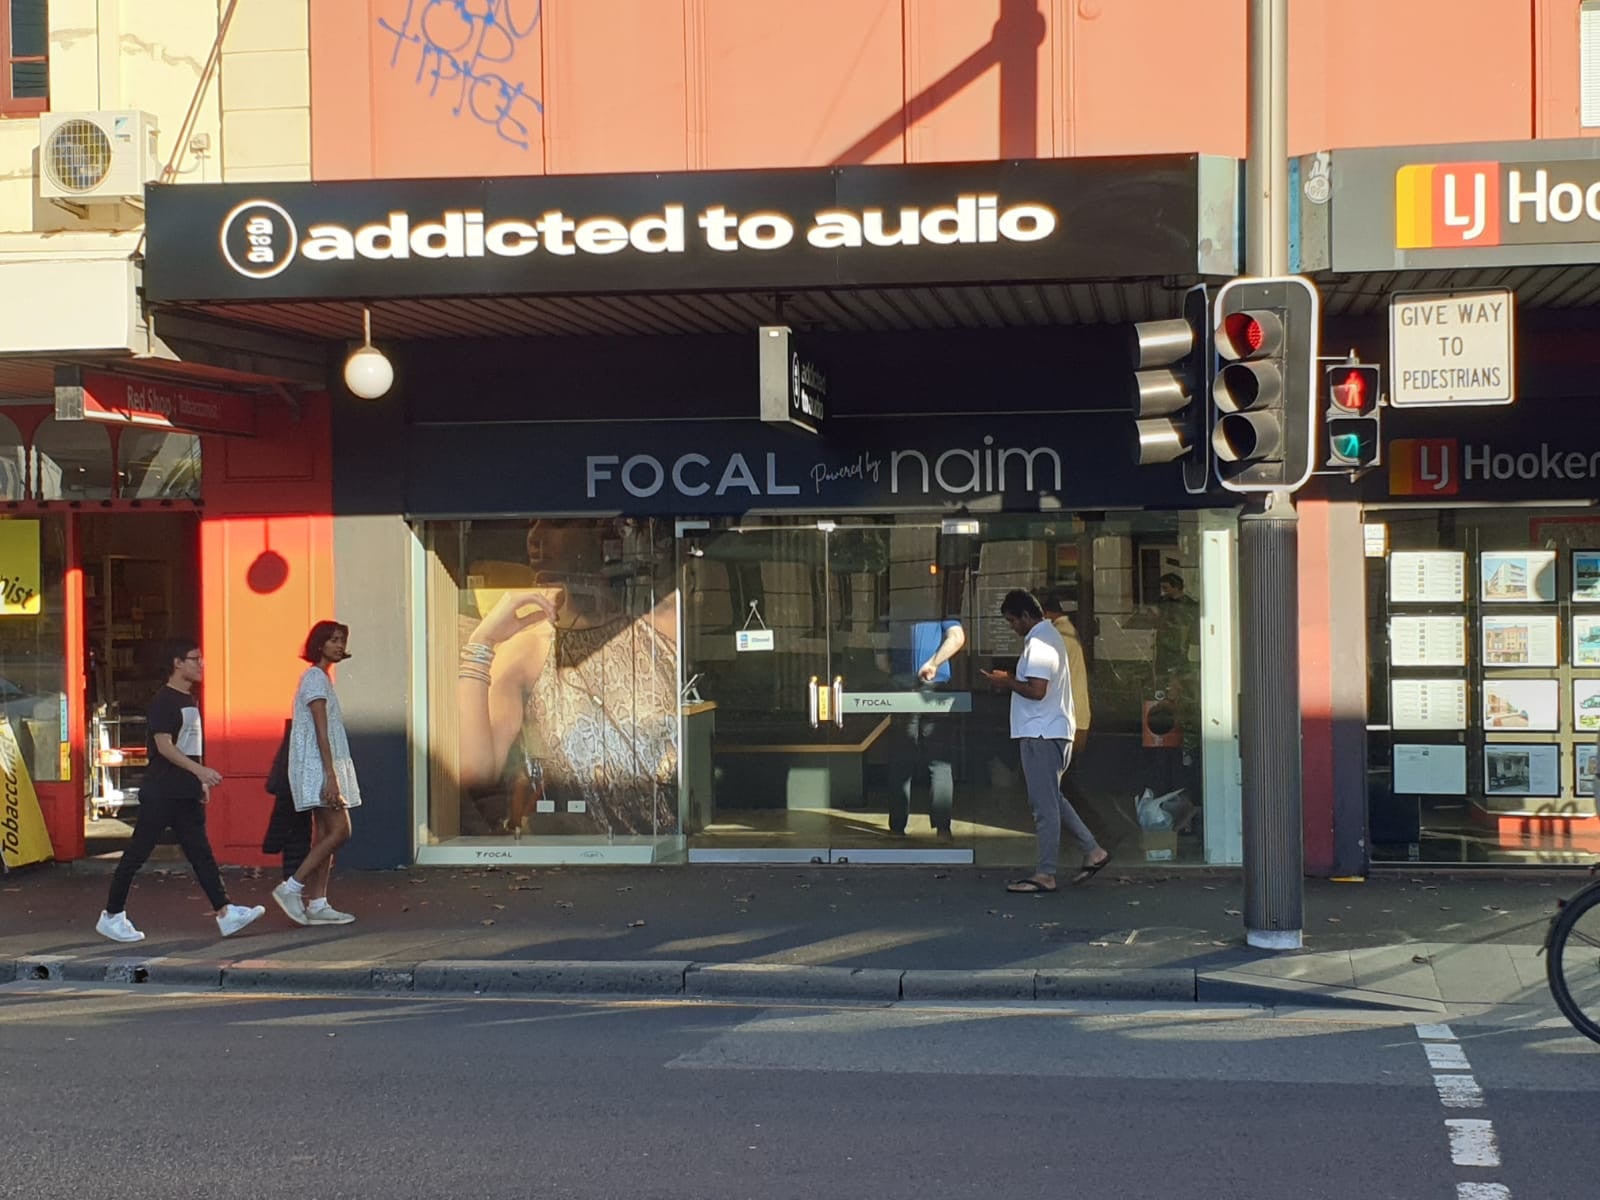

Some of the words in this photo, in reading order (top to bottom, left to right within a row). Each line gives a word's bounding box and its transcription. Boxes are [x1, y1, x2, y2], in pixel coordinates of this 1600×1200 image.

[1444, 172, 1486, 240] LJ
[301, 204, 685, 260] addicted
[698, 205, 794, 251] to
[806, 194, 1056, 248] audio
[1400, 305, 1448, 326] GIVE
[1457, 301, 1503, 324] WAY
[1438, 336, 1464, 357] TO
[1402, 367, 1501, 390] PEDESTRIANS
[127, 385, 145, 411] Red
[148, 387, 171, 416] Shop
[586, 452, 800, 498] FOCAL
[810, 455, 863, 495] Powered
[865, 450, 881, 483] by
[891, 435, 1062, 494] naim
[1420, 445, 1449, 490] LJ
[484, 851, 512, 859] FOCAL
